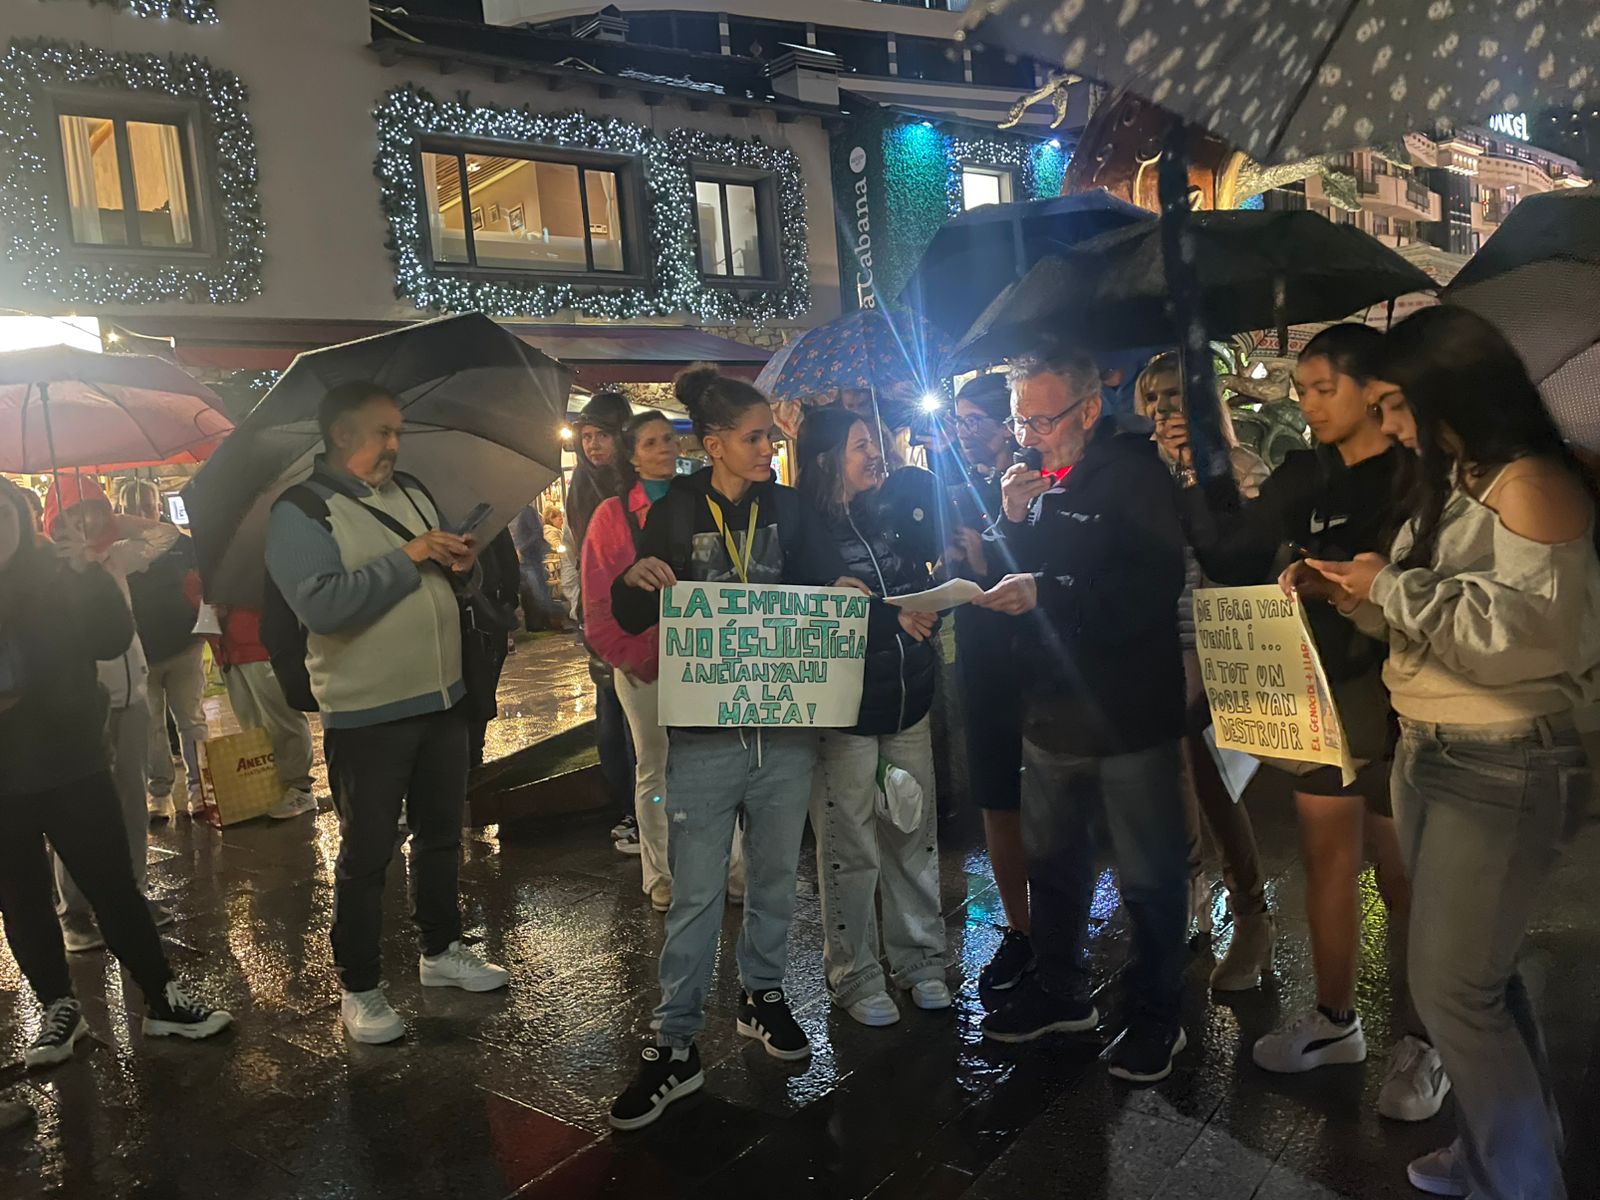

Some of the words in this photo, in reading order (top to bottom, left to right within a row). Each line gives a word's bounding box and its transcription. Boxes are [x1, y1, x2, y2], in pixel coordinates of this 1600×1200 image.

[854, 177, 875, 309] aCabana
[662, 586, 713, 618] LA
[718, 588, 870, 619] IMPUNITAT
[1197, 599, 1212, 622] DE
[1256, 599, 1294, 618] VAN
[666, 627, 713, 658] NO
[719, 619, 759, 658] ÉS
[1300, 637, 1313, 671] LLAR
[1205, 657, 1217, 681] A
[1217, 661, 1249, 685] TOT
[1256, 664, 1285, 688] UN
[733, 684, 751, 702] A
[762, 684, 794, 701] LA
[1256, 691, 1298, 717] VAN
[1311, 737, 1321, 752] EL
